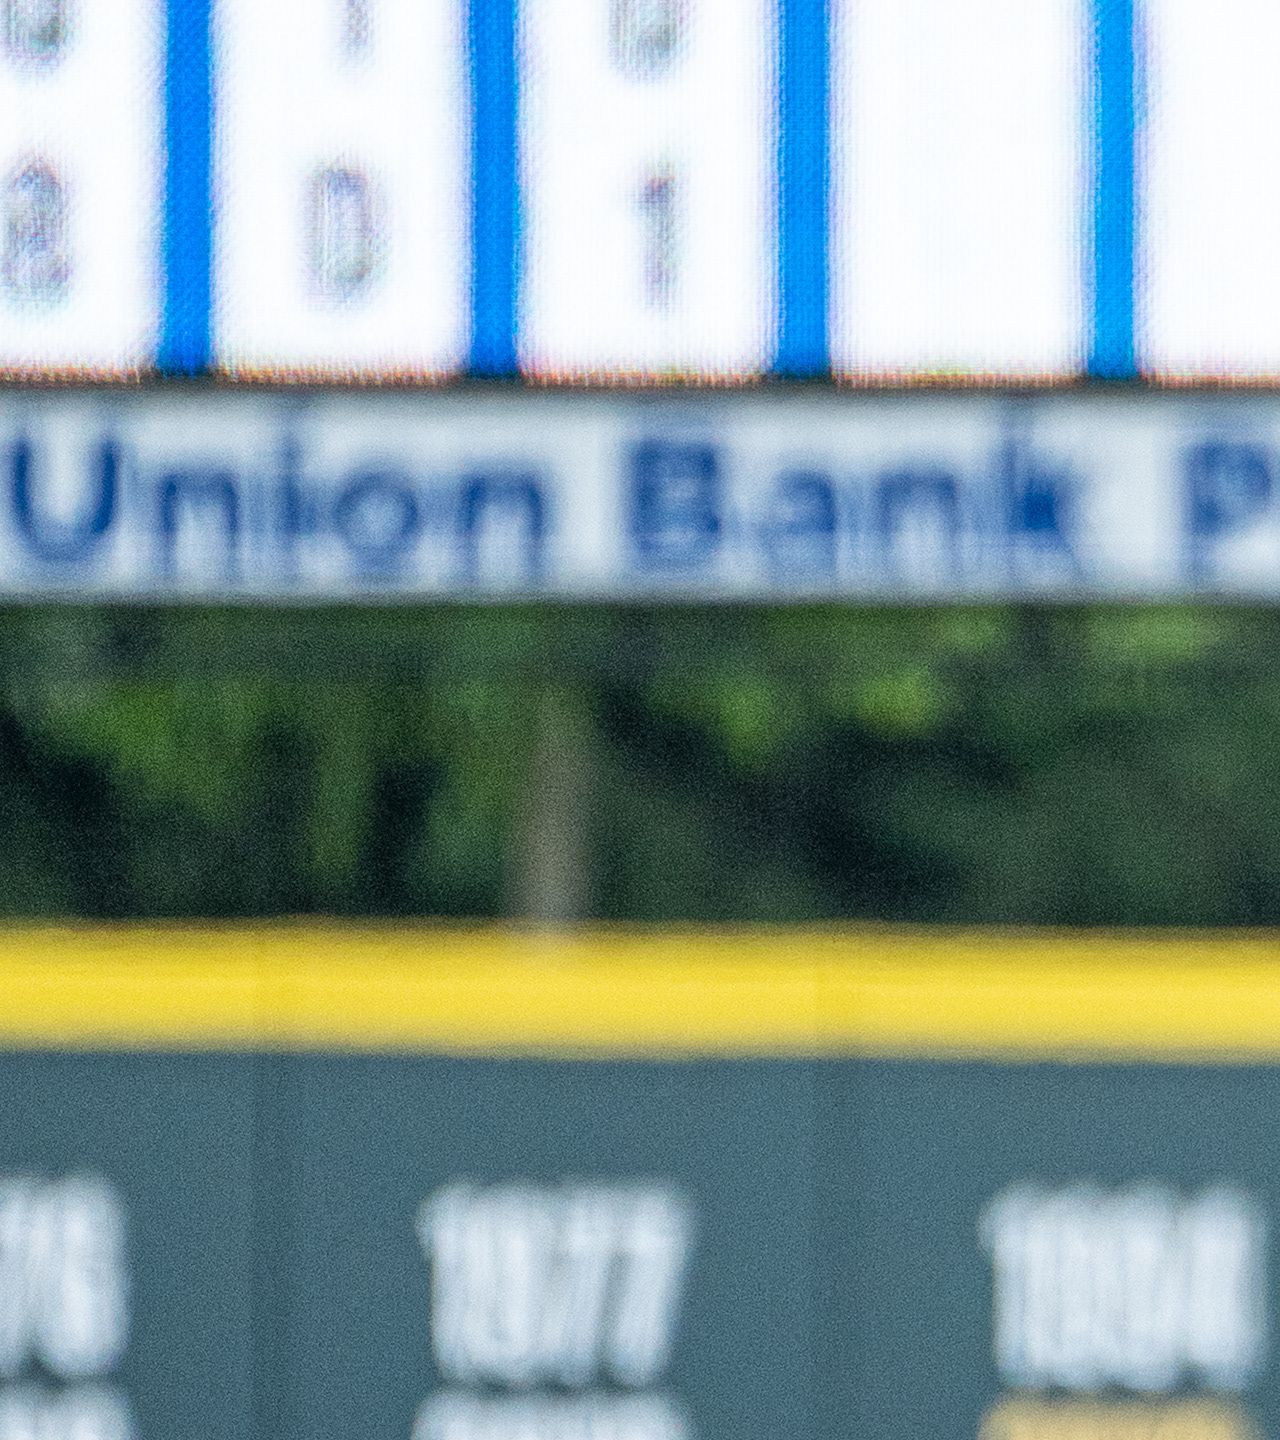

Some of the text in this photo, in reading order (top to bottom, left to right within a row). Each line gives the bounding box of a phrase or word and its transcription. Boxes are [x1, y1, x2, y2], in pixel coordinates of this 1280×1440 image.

[632, 158, 685, 312] 1
[5, 412, 553, 582] Union
[622, 412, 1082, 582] Bank
